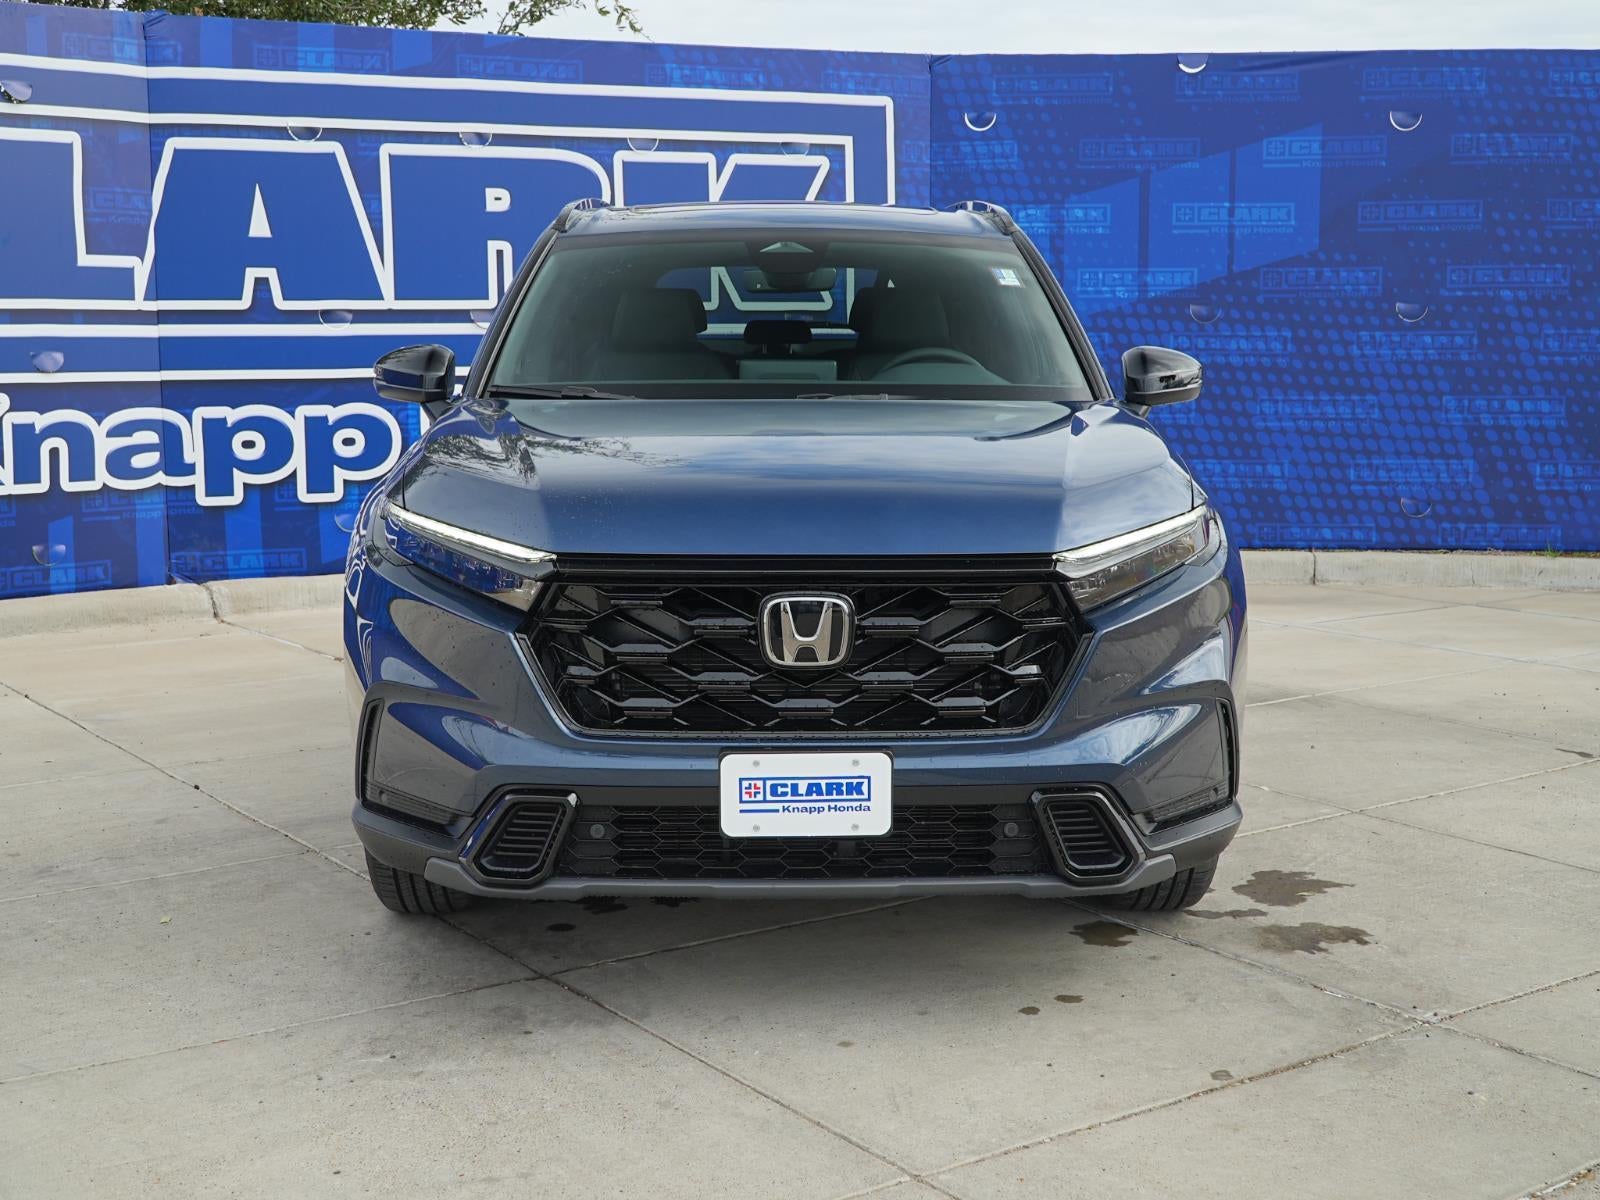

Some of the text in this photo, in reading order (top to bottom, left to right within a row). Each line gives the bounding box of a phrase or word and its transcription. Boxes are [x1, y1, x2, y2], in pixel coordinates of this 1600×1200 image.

[0, 391, 401, 506] napp
[769, 781, 865, 798] CLARK
[782, 803, 871, 815] Knapp Honda
